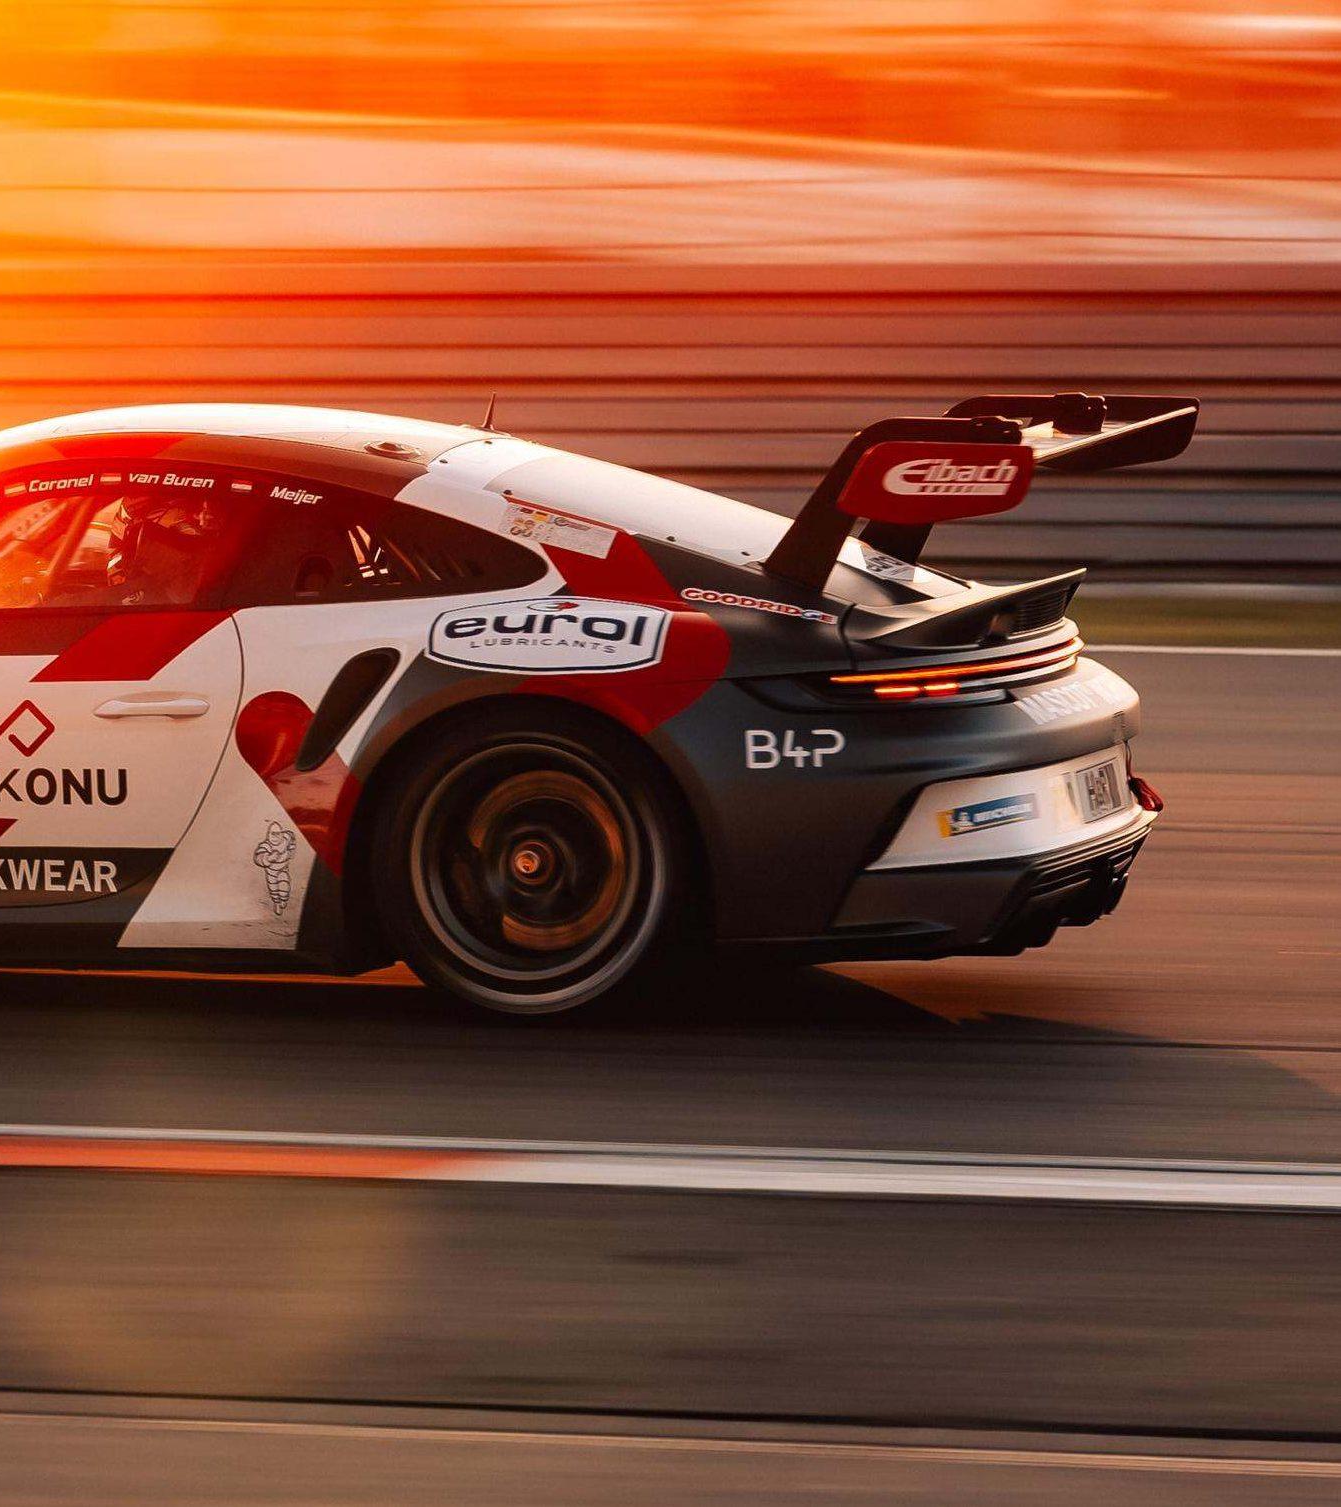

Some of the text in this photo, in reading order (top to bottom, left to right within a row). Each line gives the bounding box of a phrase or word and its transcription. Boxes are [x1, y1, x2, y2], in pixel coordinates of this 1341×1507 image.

[29, 474, 94, 493] Coronel
[129, 473, 214, 488] van Buren
[883, 459, 1018, 495] Eibach
[270, 486, 323, 505] Meijer
[680, 588, 838, 625] GOODRIDGE
[444, 614, 648, 646] eurol
[469, 637, 617, 654] LUBRICANTS
[744, 729, 845, 769] B4P
